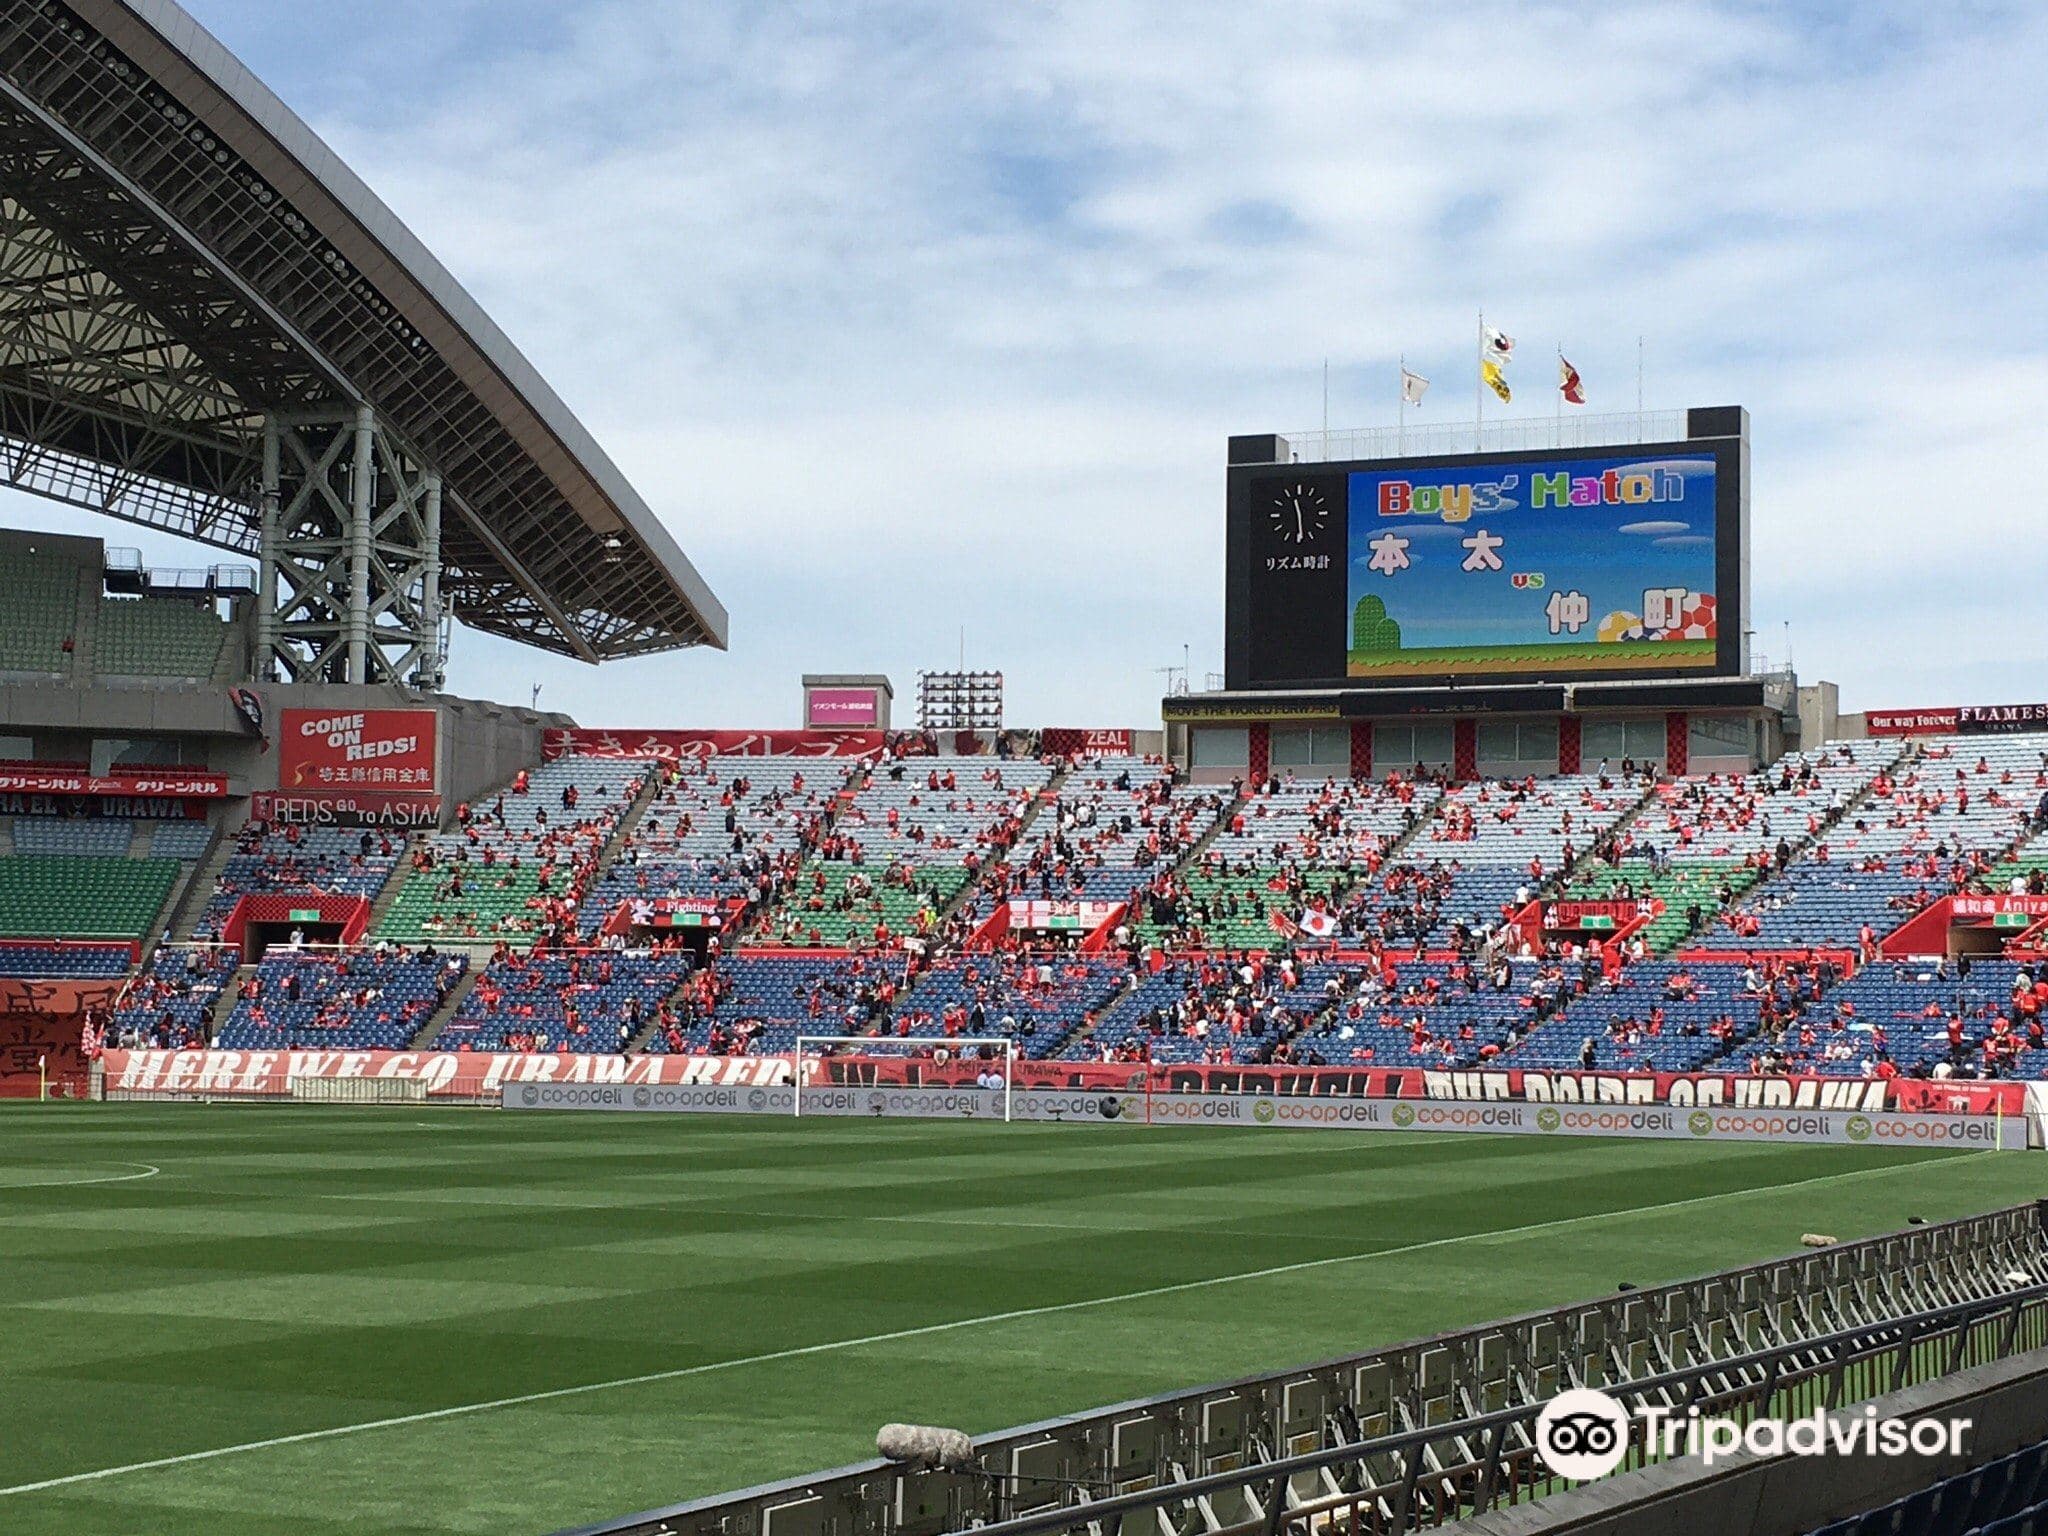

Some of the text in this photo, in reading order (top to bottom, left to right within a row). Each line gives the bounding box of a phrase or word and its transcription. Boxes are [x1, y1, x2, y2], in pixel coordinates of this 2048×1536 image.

[1531, 468, 1684, 509] Match
[1266, 555, 1330, 570] リズム時計
[301, 714, 365, 736] COME
[1894, 716, 1915, 728] way
[327, 729, 361, 748] ON
[1087, 731, 1127, 745] ZEAL
[346, 736, 417, 761] REDS!
[102, 798, 186, 817] URAWA
[336, 799, 356, 812] GO
[380, 802, 441, 826] ASIA!
[666, 900, 718, 914] Fighting
[116, 1051, 281, 1090] HERE
[287, 1052, 373, 1090] WE
[377, 1053, 459, 1092] GO
[482, 1054, 665, 1091] URAWA
[541, 1088, 623, 1106] co-opdeli
[653, 1090, 738, 1108] co-opdeli
[1278, 1103, 1379, 1125] co-opdeli
[1417, 1106, 1522, 1127] co-opdeli
[1563, 1111, 1674, 1131] co-opdeli
[1715, 1115, 1830, 1136] co-opdeli
[1875, 1119, 1997, 1141] co-opdeli
